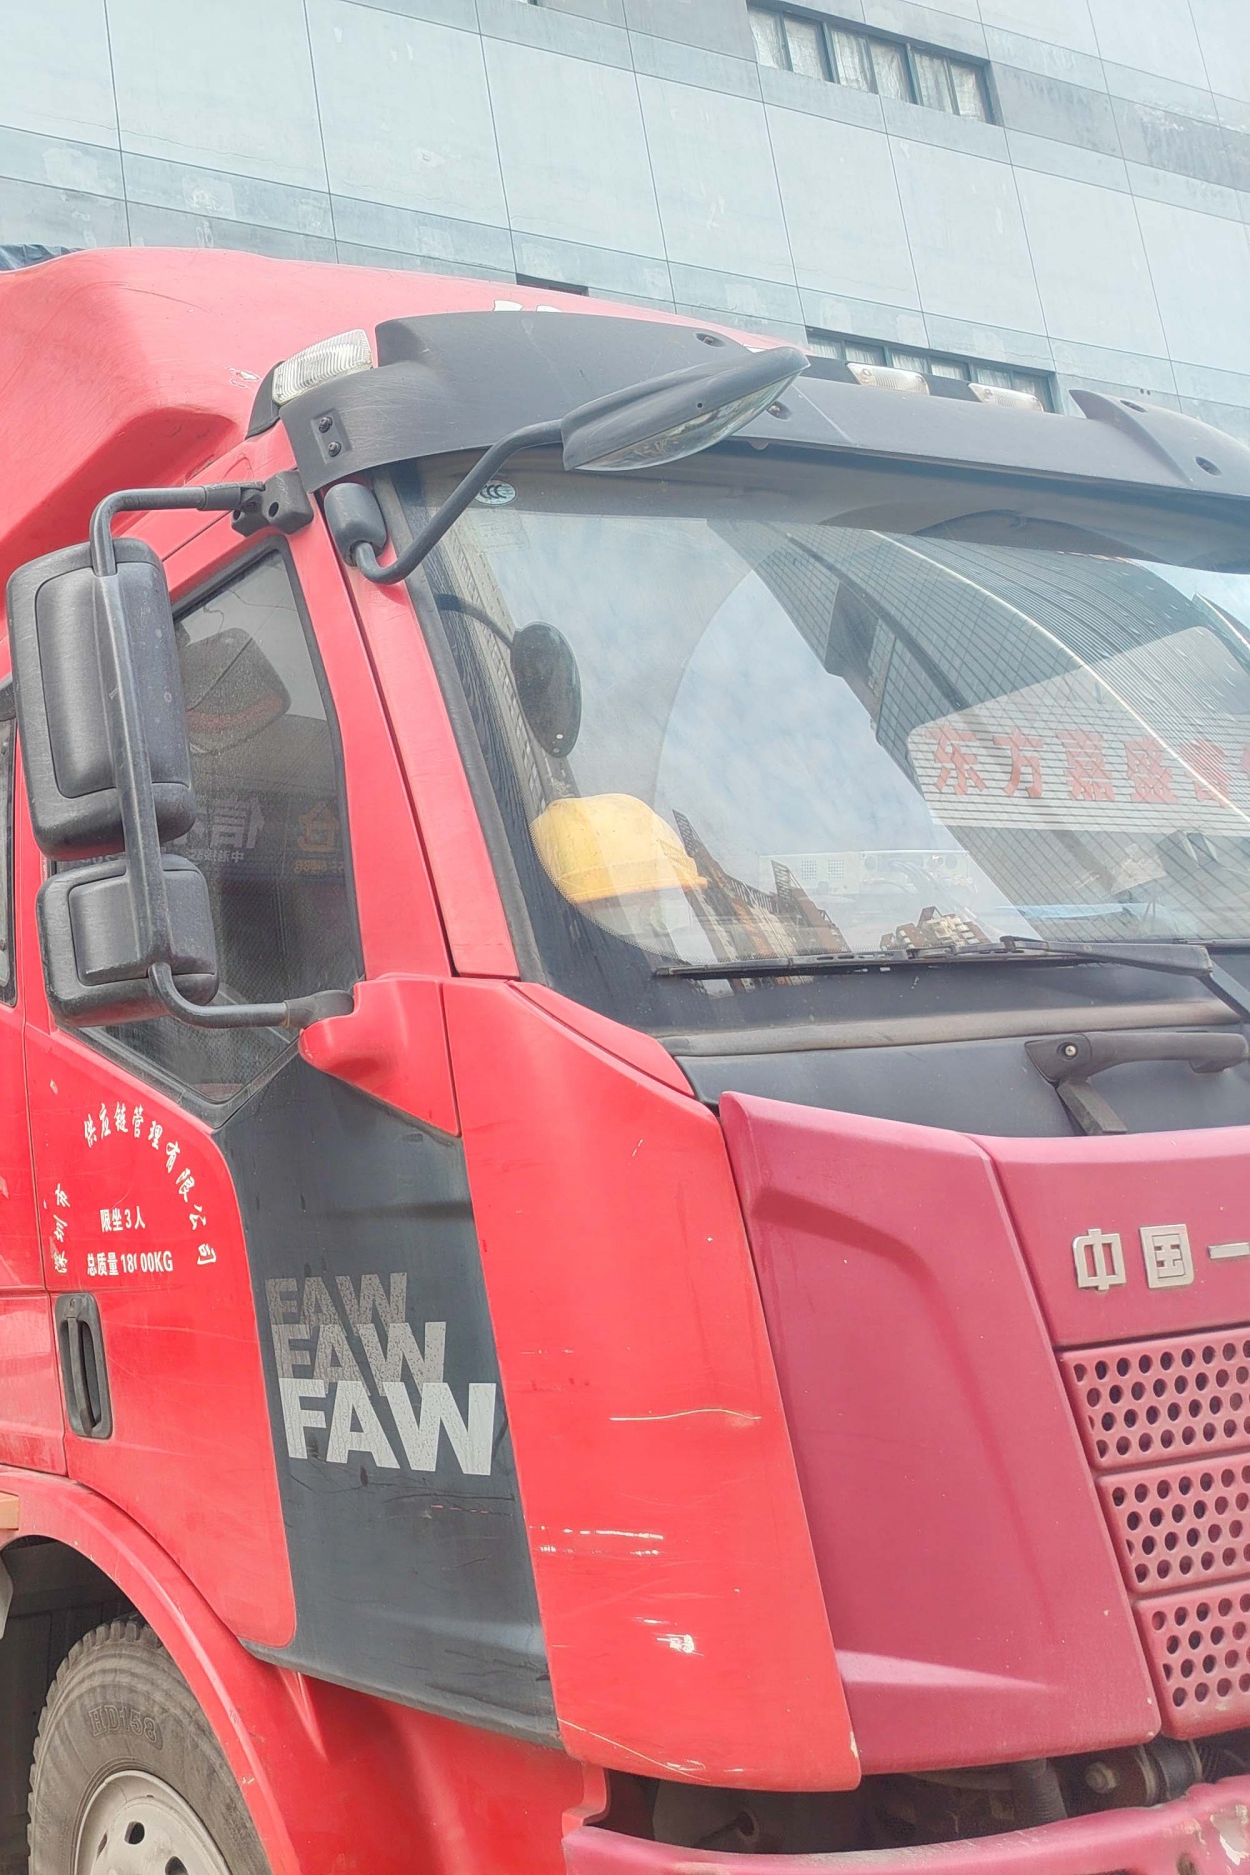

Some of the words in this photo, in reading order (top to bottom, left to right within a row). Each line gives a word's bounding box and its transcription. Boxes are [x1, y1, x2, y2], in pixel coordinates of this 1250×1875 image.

[265, 1272, 407, 1336] FAW
[271, 1321, 447, 1397] FAW
[279, 1377, 497, 1475] FAW
